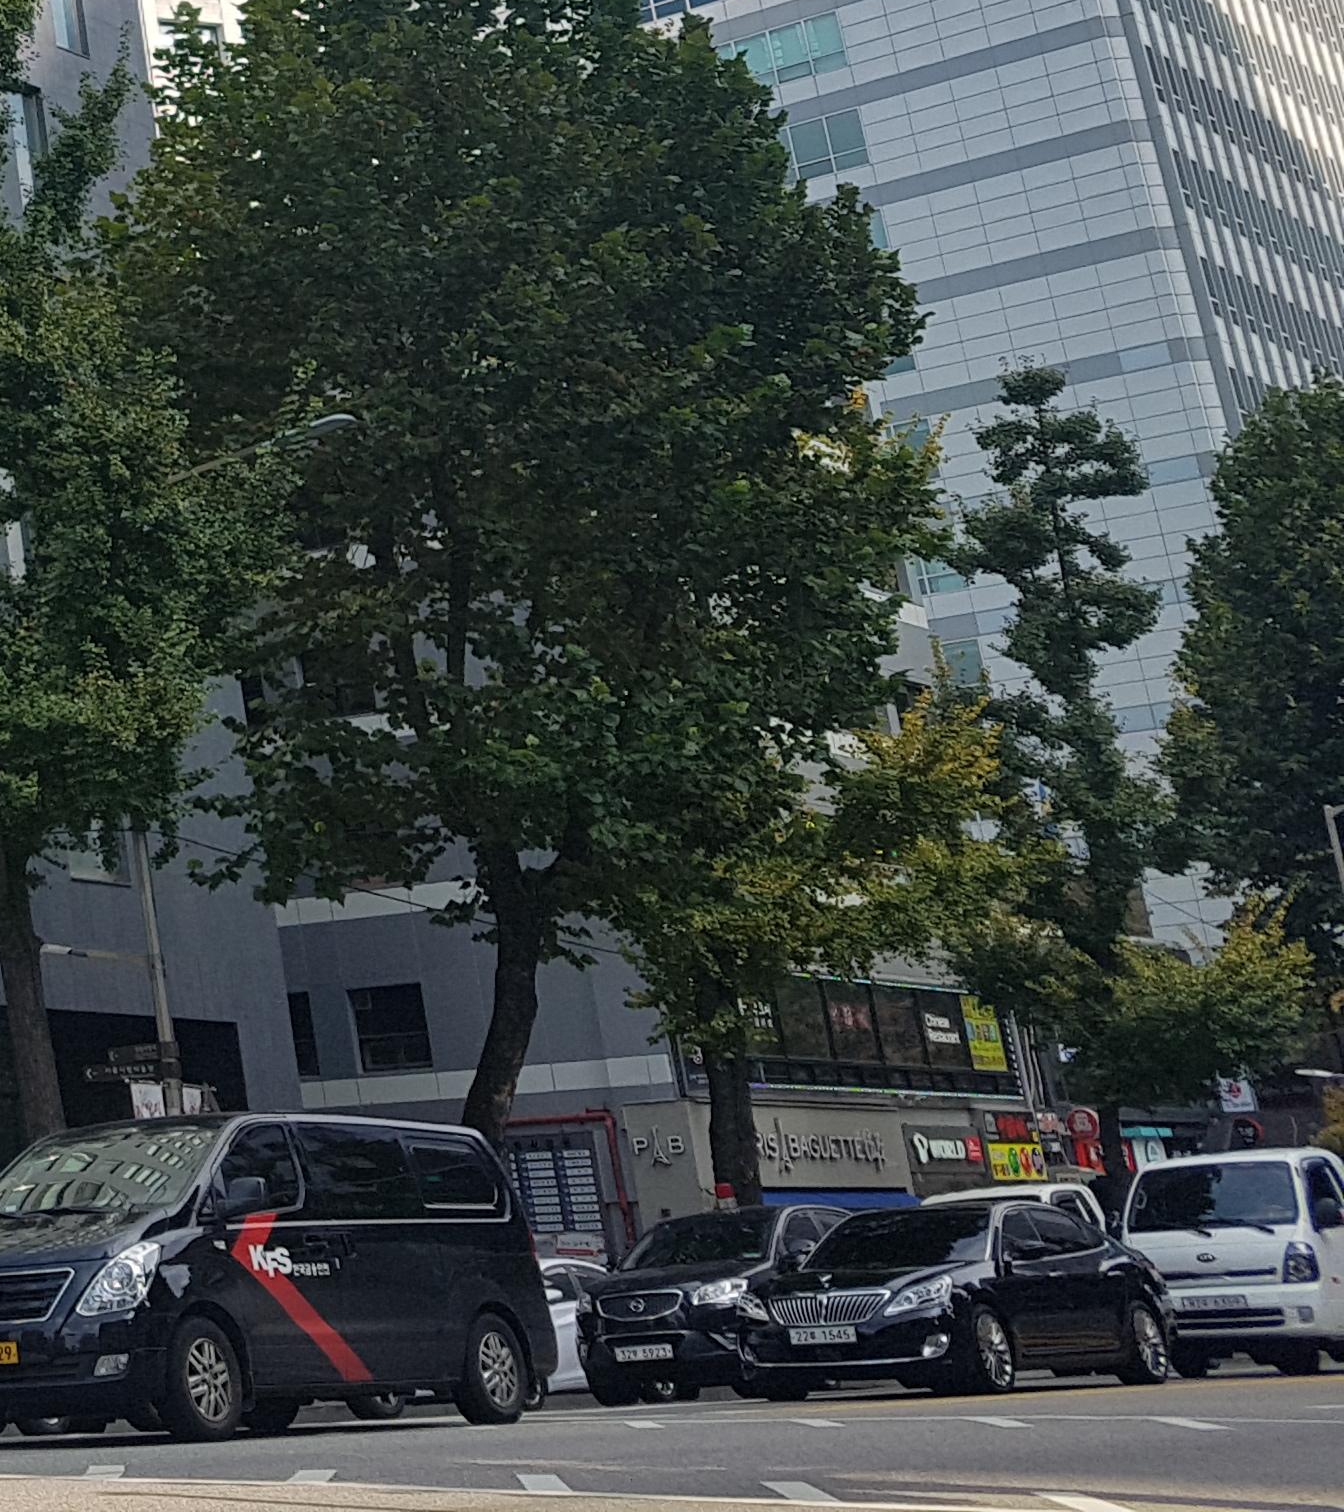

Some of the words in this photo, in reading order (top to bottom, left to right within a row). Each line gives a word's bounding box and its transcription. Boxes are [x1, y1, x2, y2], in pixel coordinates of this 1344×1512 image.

[790, 1134, 866, 1160] BAGUETTE
[928, 1139, 967, 1160] WORLD
[248, 1244, 293, 1278] KFS
